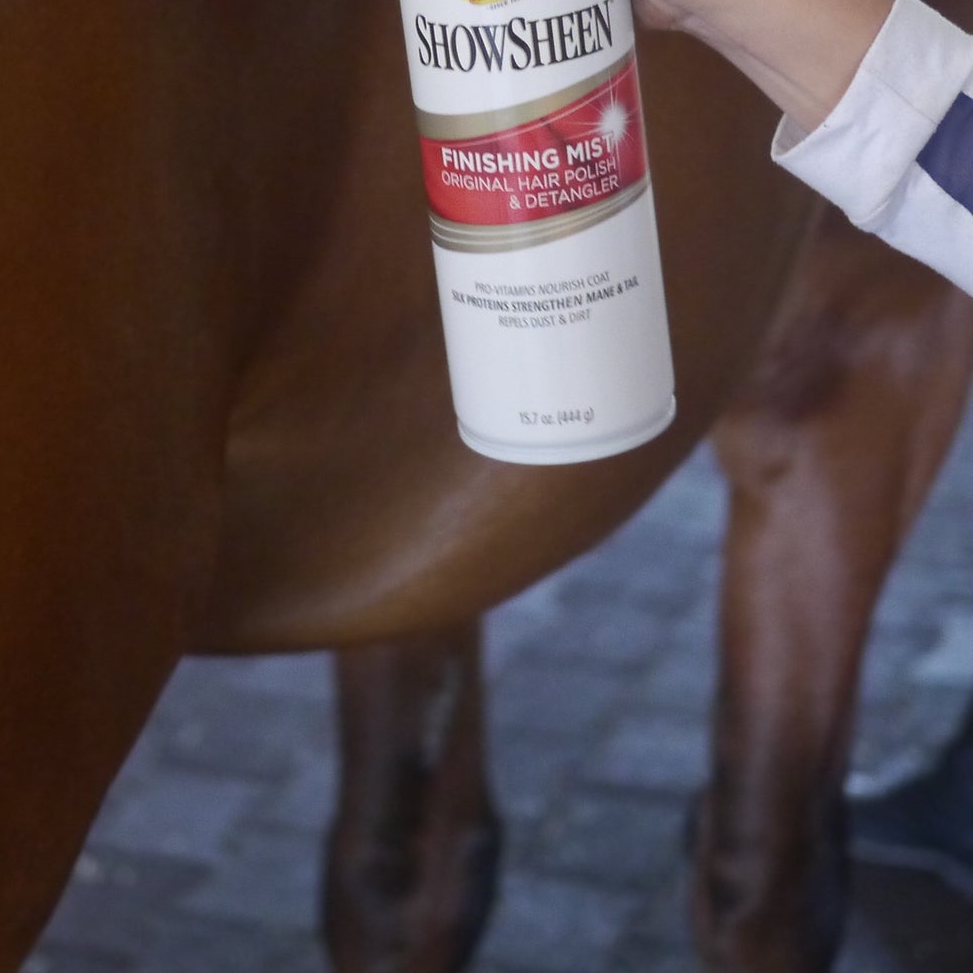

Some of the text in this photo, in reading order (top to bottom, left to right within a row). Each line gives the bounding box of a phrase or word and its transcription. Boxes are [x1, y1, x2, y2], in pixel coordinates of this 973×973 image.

[440, 132, 615, 174] FINISHING MIST
[441, 157, 617, 193] ORIGINAL HAIR POLISH
[508, 174, 620, 210] & DETANGLER
[466, 293, 509, 312] PROTEINS
[512, 294, 583, 313] STRENGTHEN
[586, 286, 615, 304] MANE
[616, 285, 624, 295] &
[624, 275, 640, 290] TAIL
[474, 271, 610, 297] PRO-VITAMINS NOURISH COAT
[498, 309, 591, 329] REPELS DUST & DIRT
[519, 411, 538, 425] 15.7
[557, 409, 581, 426] (444
[583, 406, 595, 424] g)
